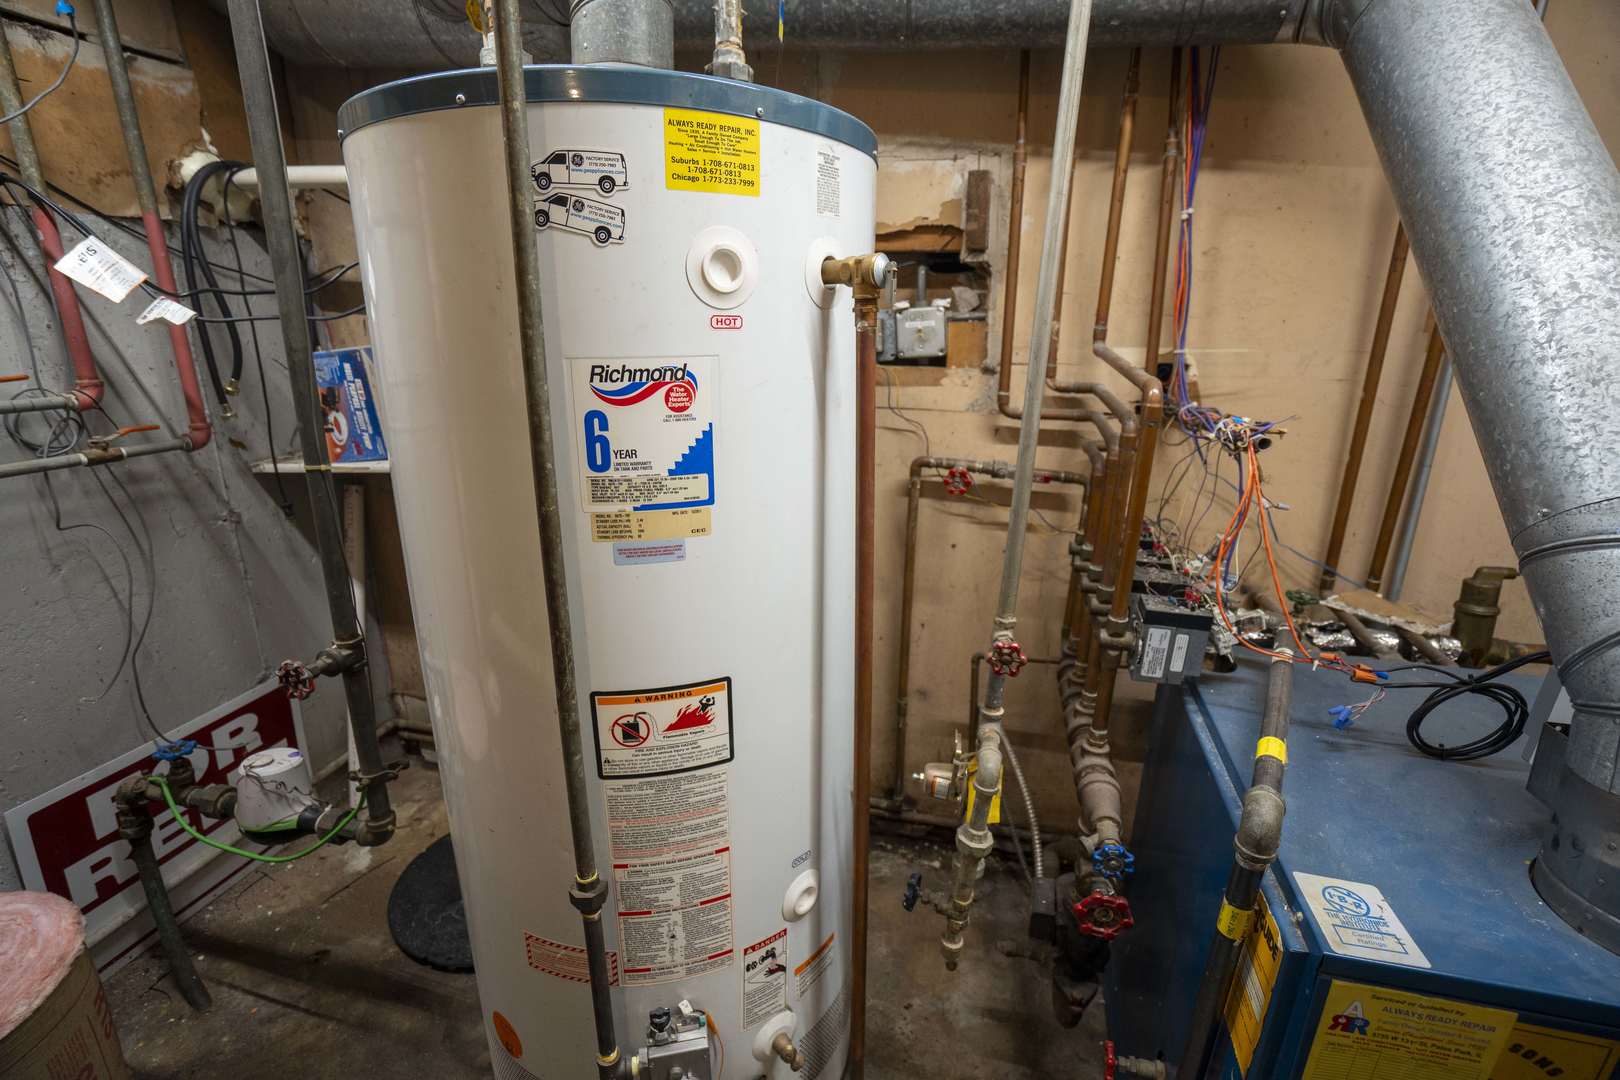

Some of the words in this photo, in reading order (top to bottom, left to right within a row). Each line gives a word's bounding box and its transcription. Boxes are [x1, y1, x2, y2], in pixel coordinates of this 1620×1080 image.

[668, 118, 694, 129] ALWAYS
[696, 121, 717, 131] READY
[719, 124, 742, 135] REPAIR,
[744, 128, 757, 137] INC.
[699, 134, 714, 142] Enough
[732, 134, 749, 142] Company
[585, 155, 604, 163] FACTORY
[671, 155, 700, 166] Suburbs
[702, 159, 755, 172] 1-708-671-0813
[687, 165, 742, 178] 1-708-671-0813
[671, 172, 700, 183] Chicago
[702, 175, 755, 188] 1-773-233-7999
[586, 203, 604, 213] FACTORY
[604, 208, 620, 217] SERVICE
[715, 317, 739, 327] HOT
[589, 362, 688, 384] Richmond
[583, 409, 612, 474] 6
[613, 448, 638, 460] YEAR
[645, 690, 693, 702] WARNING
[754, 930, 787, 951] DANGER
[1382, 1005, 1425, 1021] ALWAYS
[1424, 1013, 1460, 1026] READY
[1459, 1019, 1498, 1033] REPAIR
